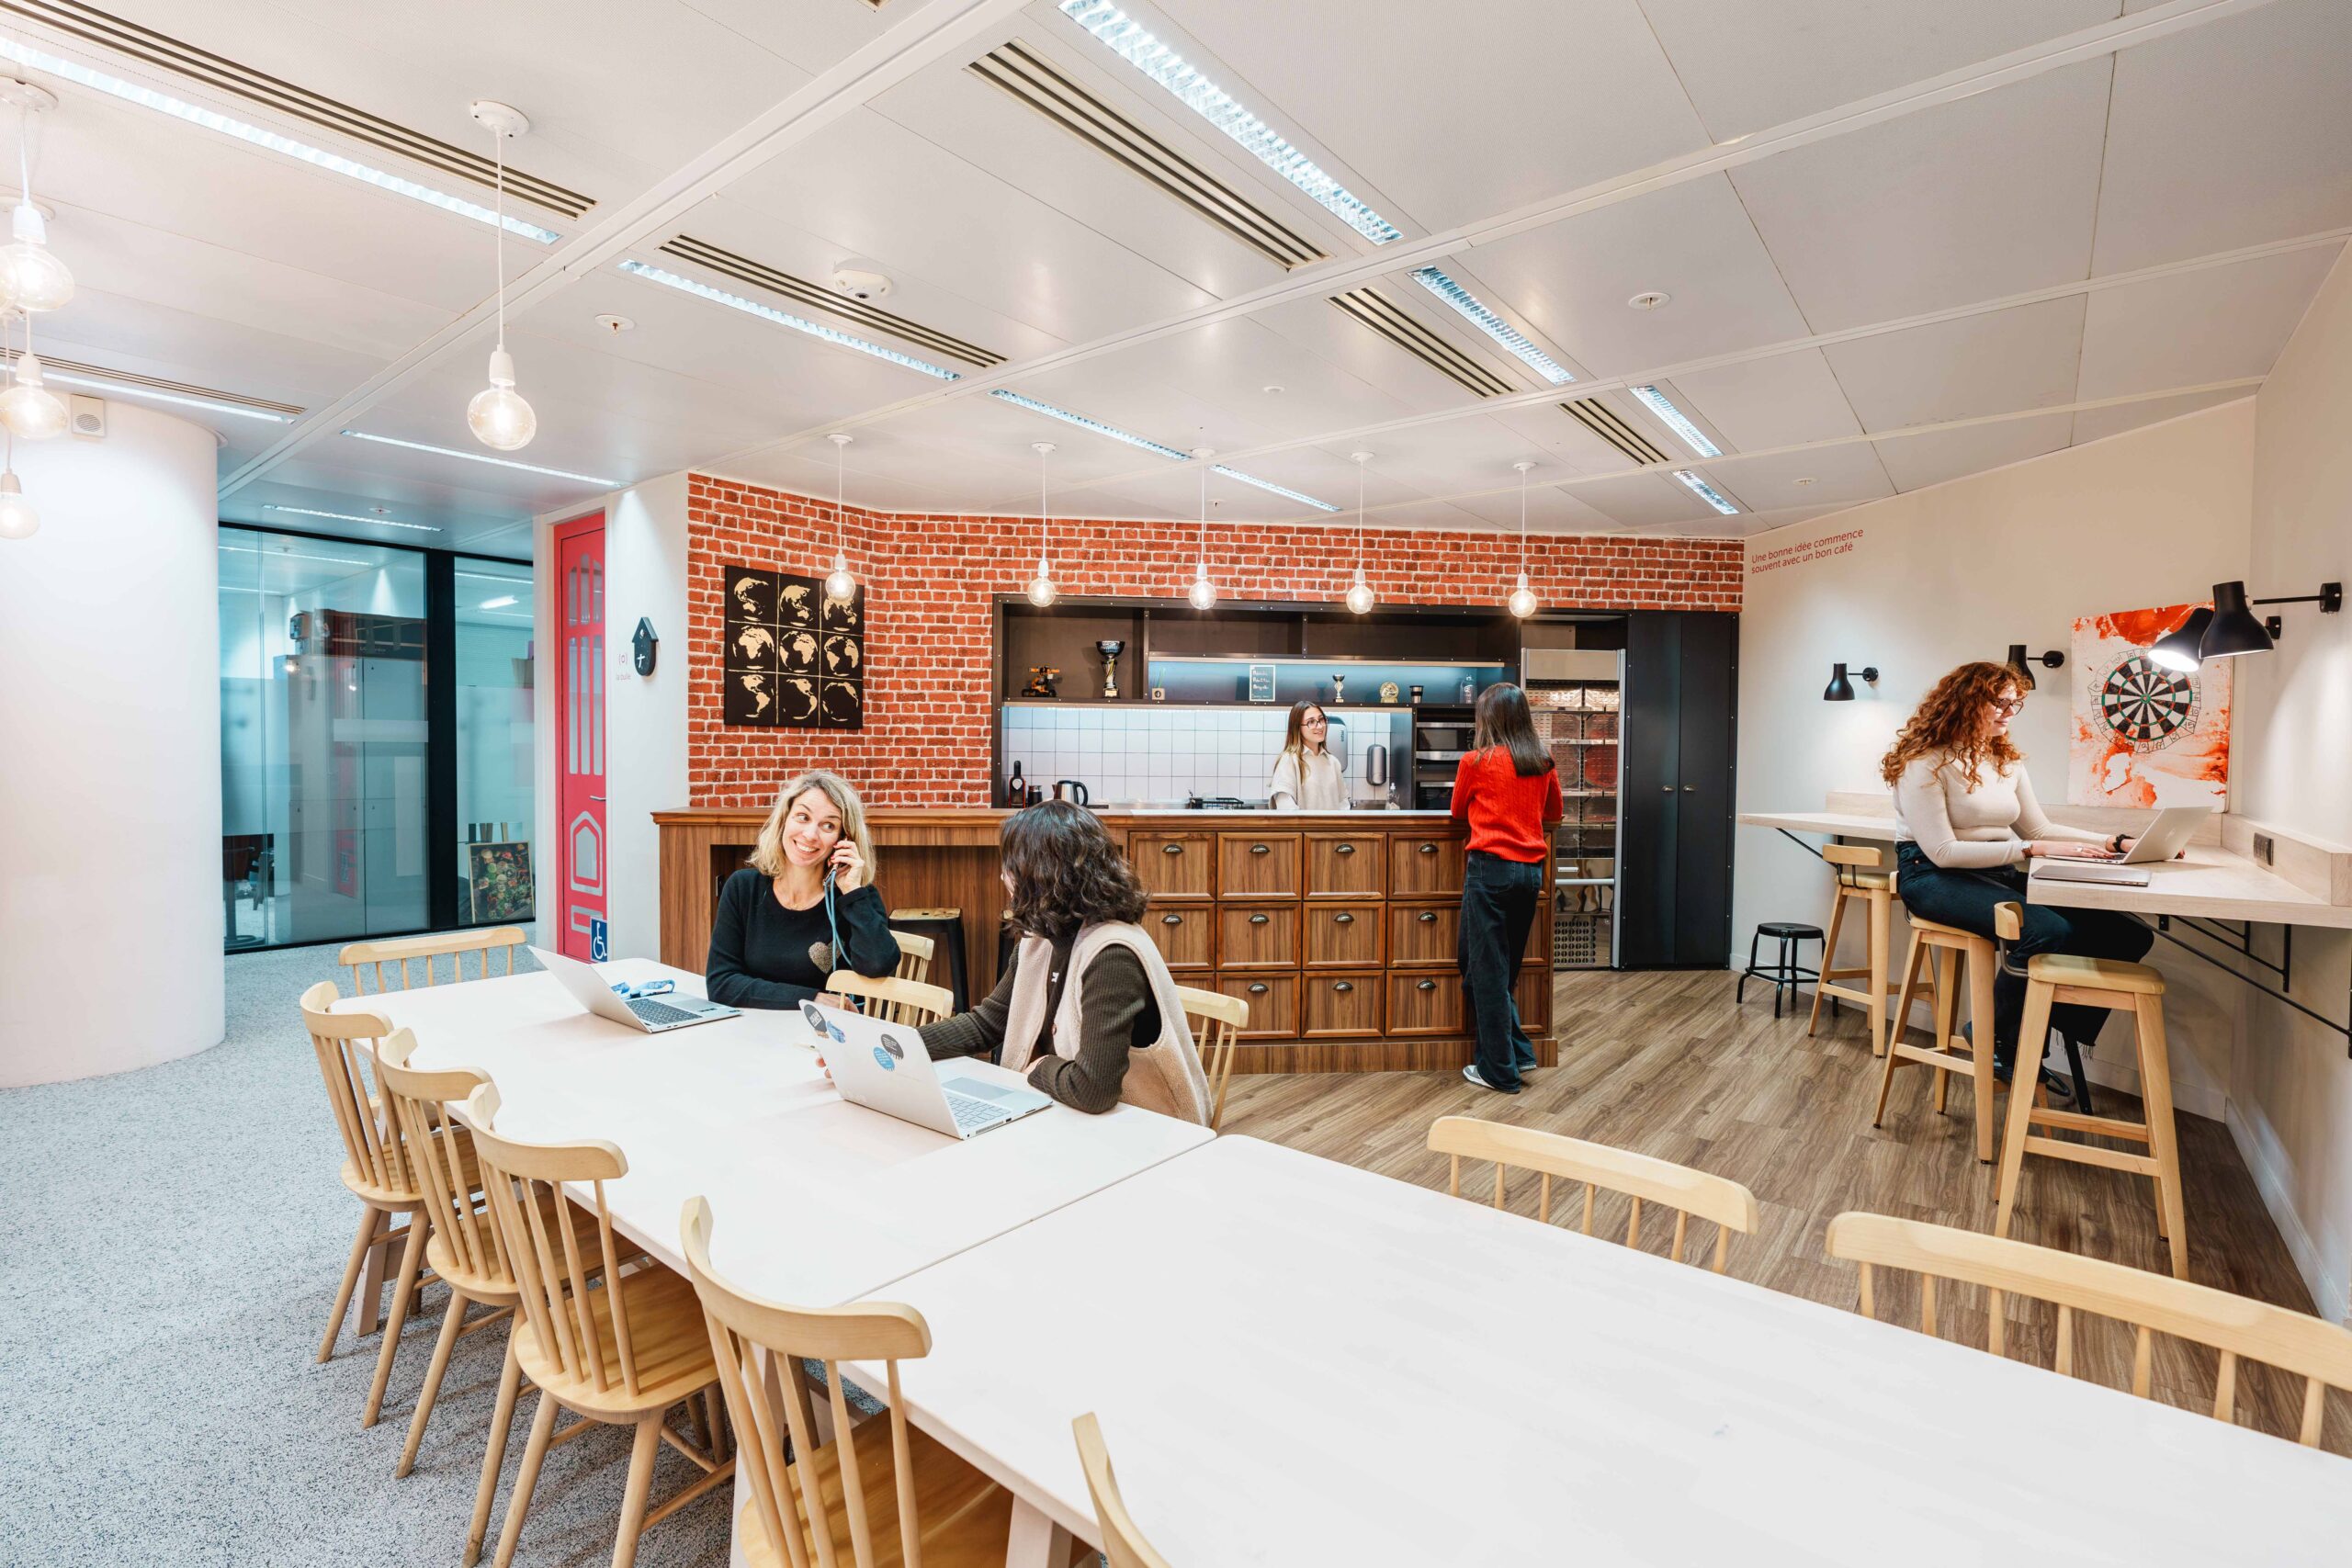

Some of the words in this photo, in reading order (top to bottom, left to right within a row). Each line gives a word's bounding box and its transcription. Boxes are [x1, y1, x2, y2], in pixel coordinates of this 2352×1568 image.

[1751, 553, 1767, 564] Une
[1768, 547, 1792, 559] bonne
[1793, 541, 1812, 553] idée
[1814, 529, 1864, 548] commence
[1751, 560, 1784, 574] souvent
[1782, 556, 1801, 567] avec
[1803, 553, 1814, 562] un
[1815, 547, 1832, 559] bon
[1834, 540, 1853, 555] café
